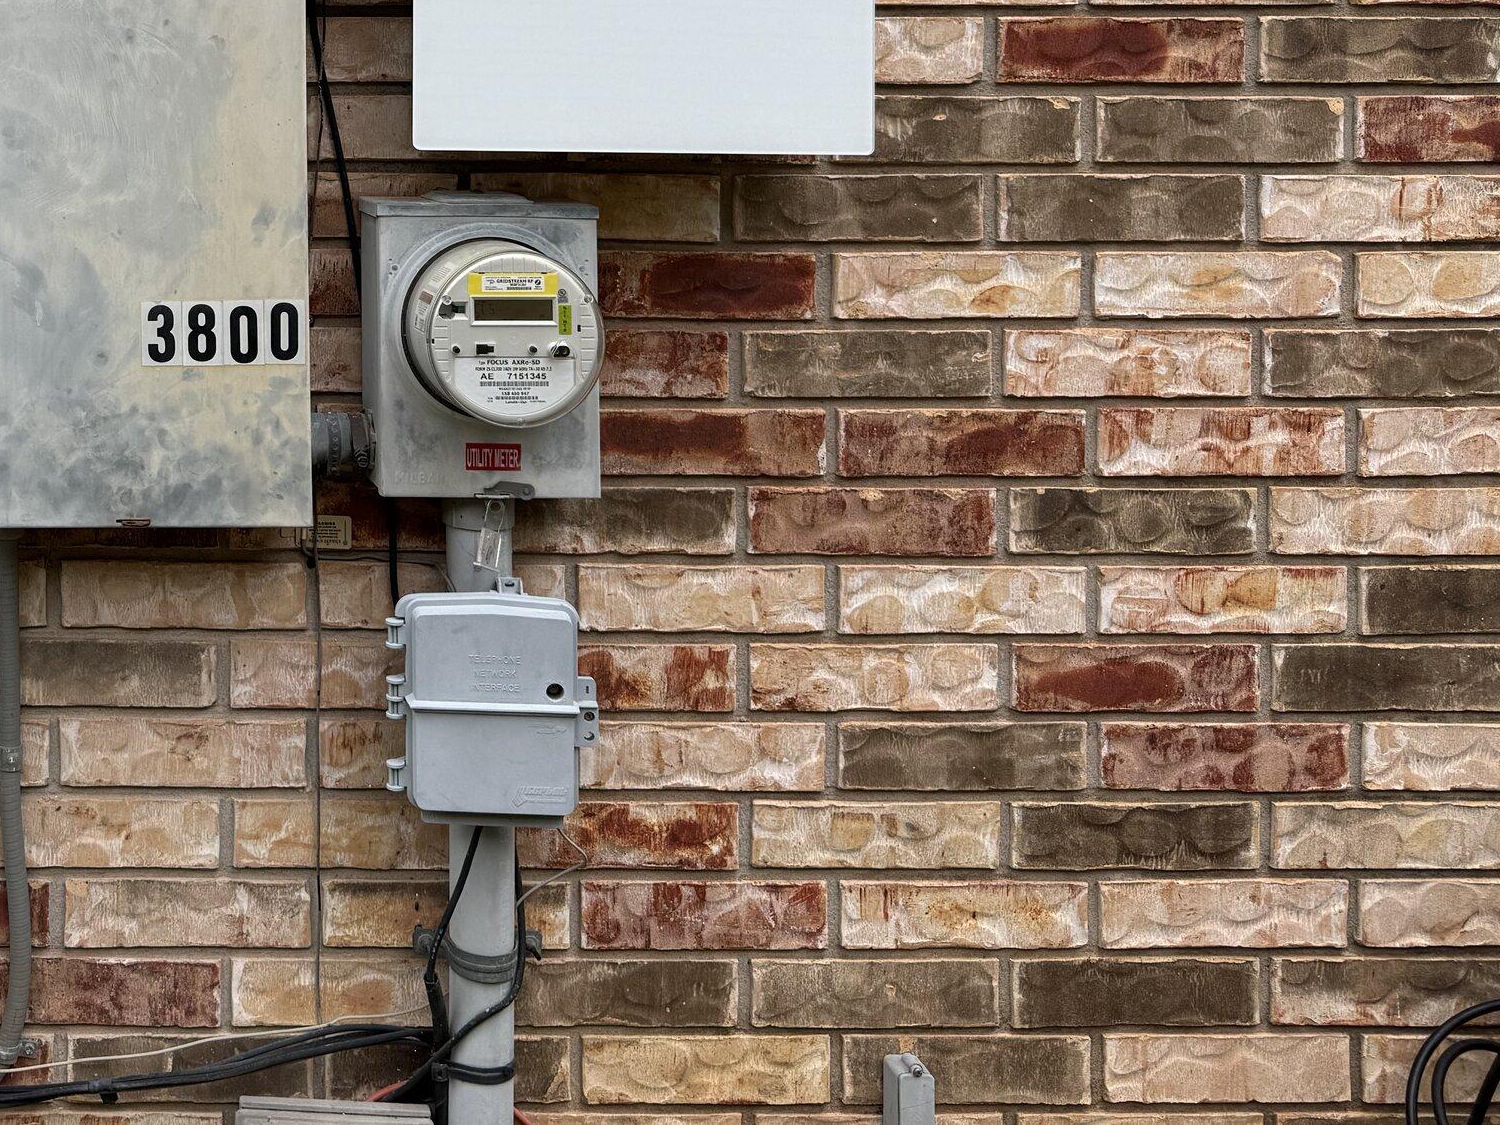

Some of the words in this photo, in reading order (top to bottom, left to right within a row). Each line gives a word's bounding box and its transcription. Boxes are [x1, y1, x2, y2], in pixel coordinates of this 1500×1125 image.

[147, 302, 299, 364] 3800
[466, 448, 493, 468] UTILITY
[494, 448, 519, 468] METER
[468, 654, 522, 665] TELEPHONE
[474, 669, 517, 678] NETWORK
[470, 682, 520, 692] INTERFACE
